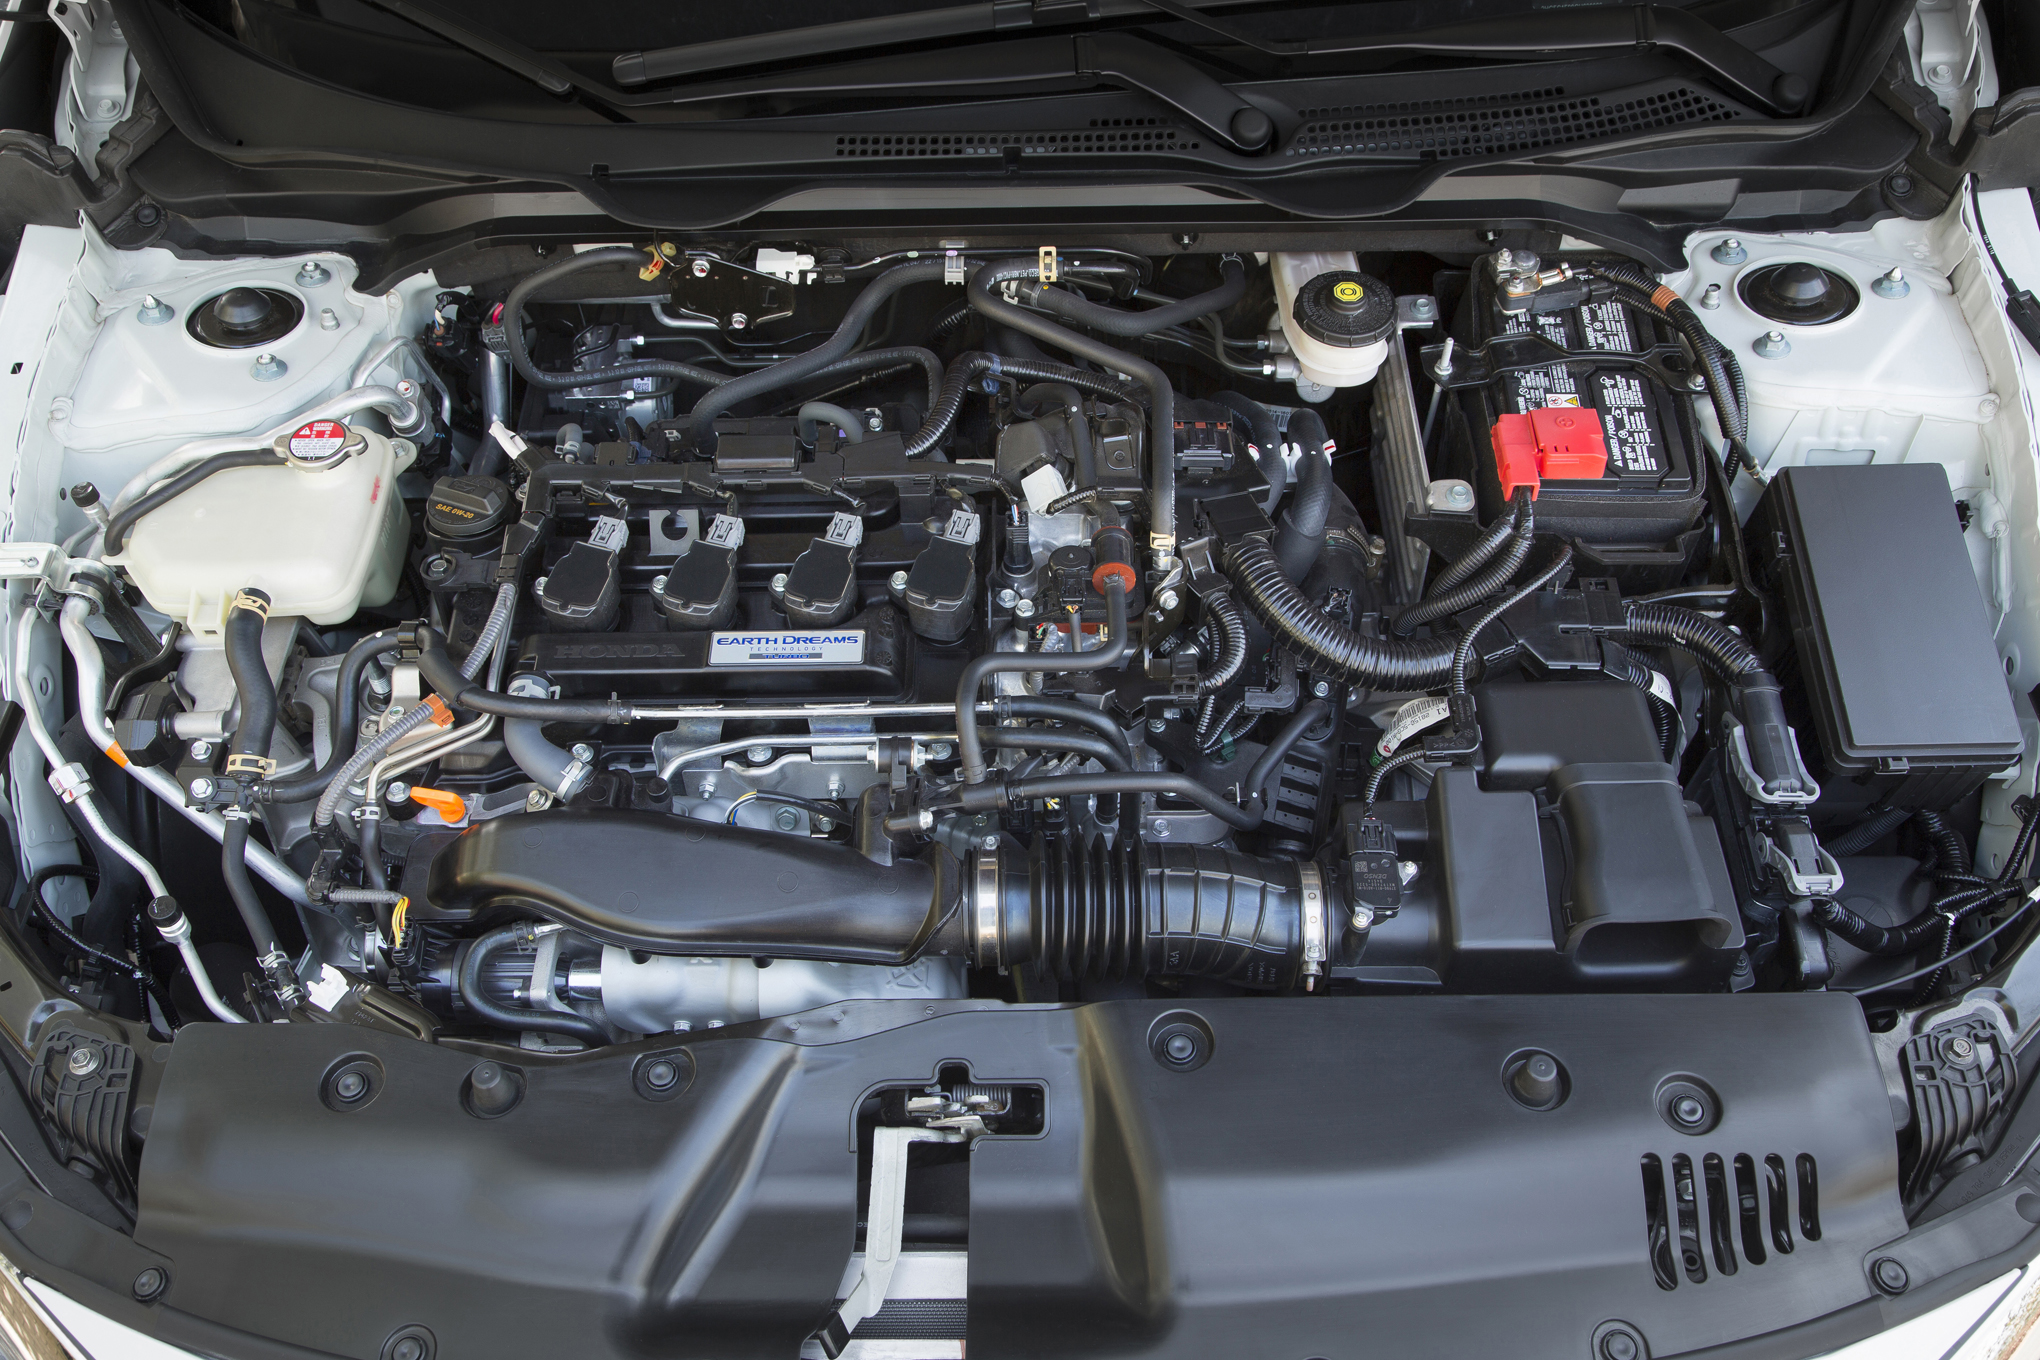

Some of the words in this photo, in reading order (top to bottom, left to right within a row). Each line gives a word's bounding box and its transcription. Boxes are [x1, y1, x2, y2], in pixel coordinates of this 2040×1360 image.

[435, 503, 453, 513] SAE
[451, 507, 475, 519] 0W-20
[716, 637, 778, 646] EARTH
[782, 635, 859, 645] DREAMS
[553, 643, 686, 659] HONDA
